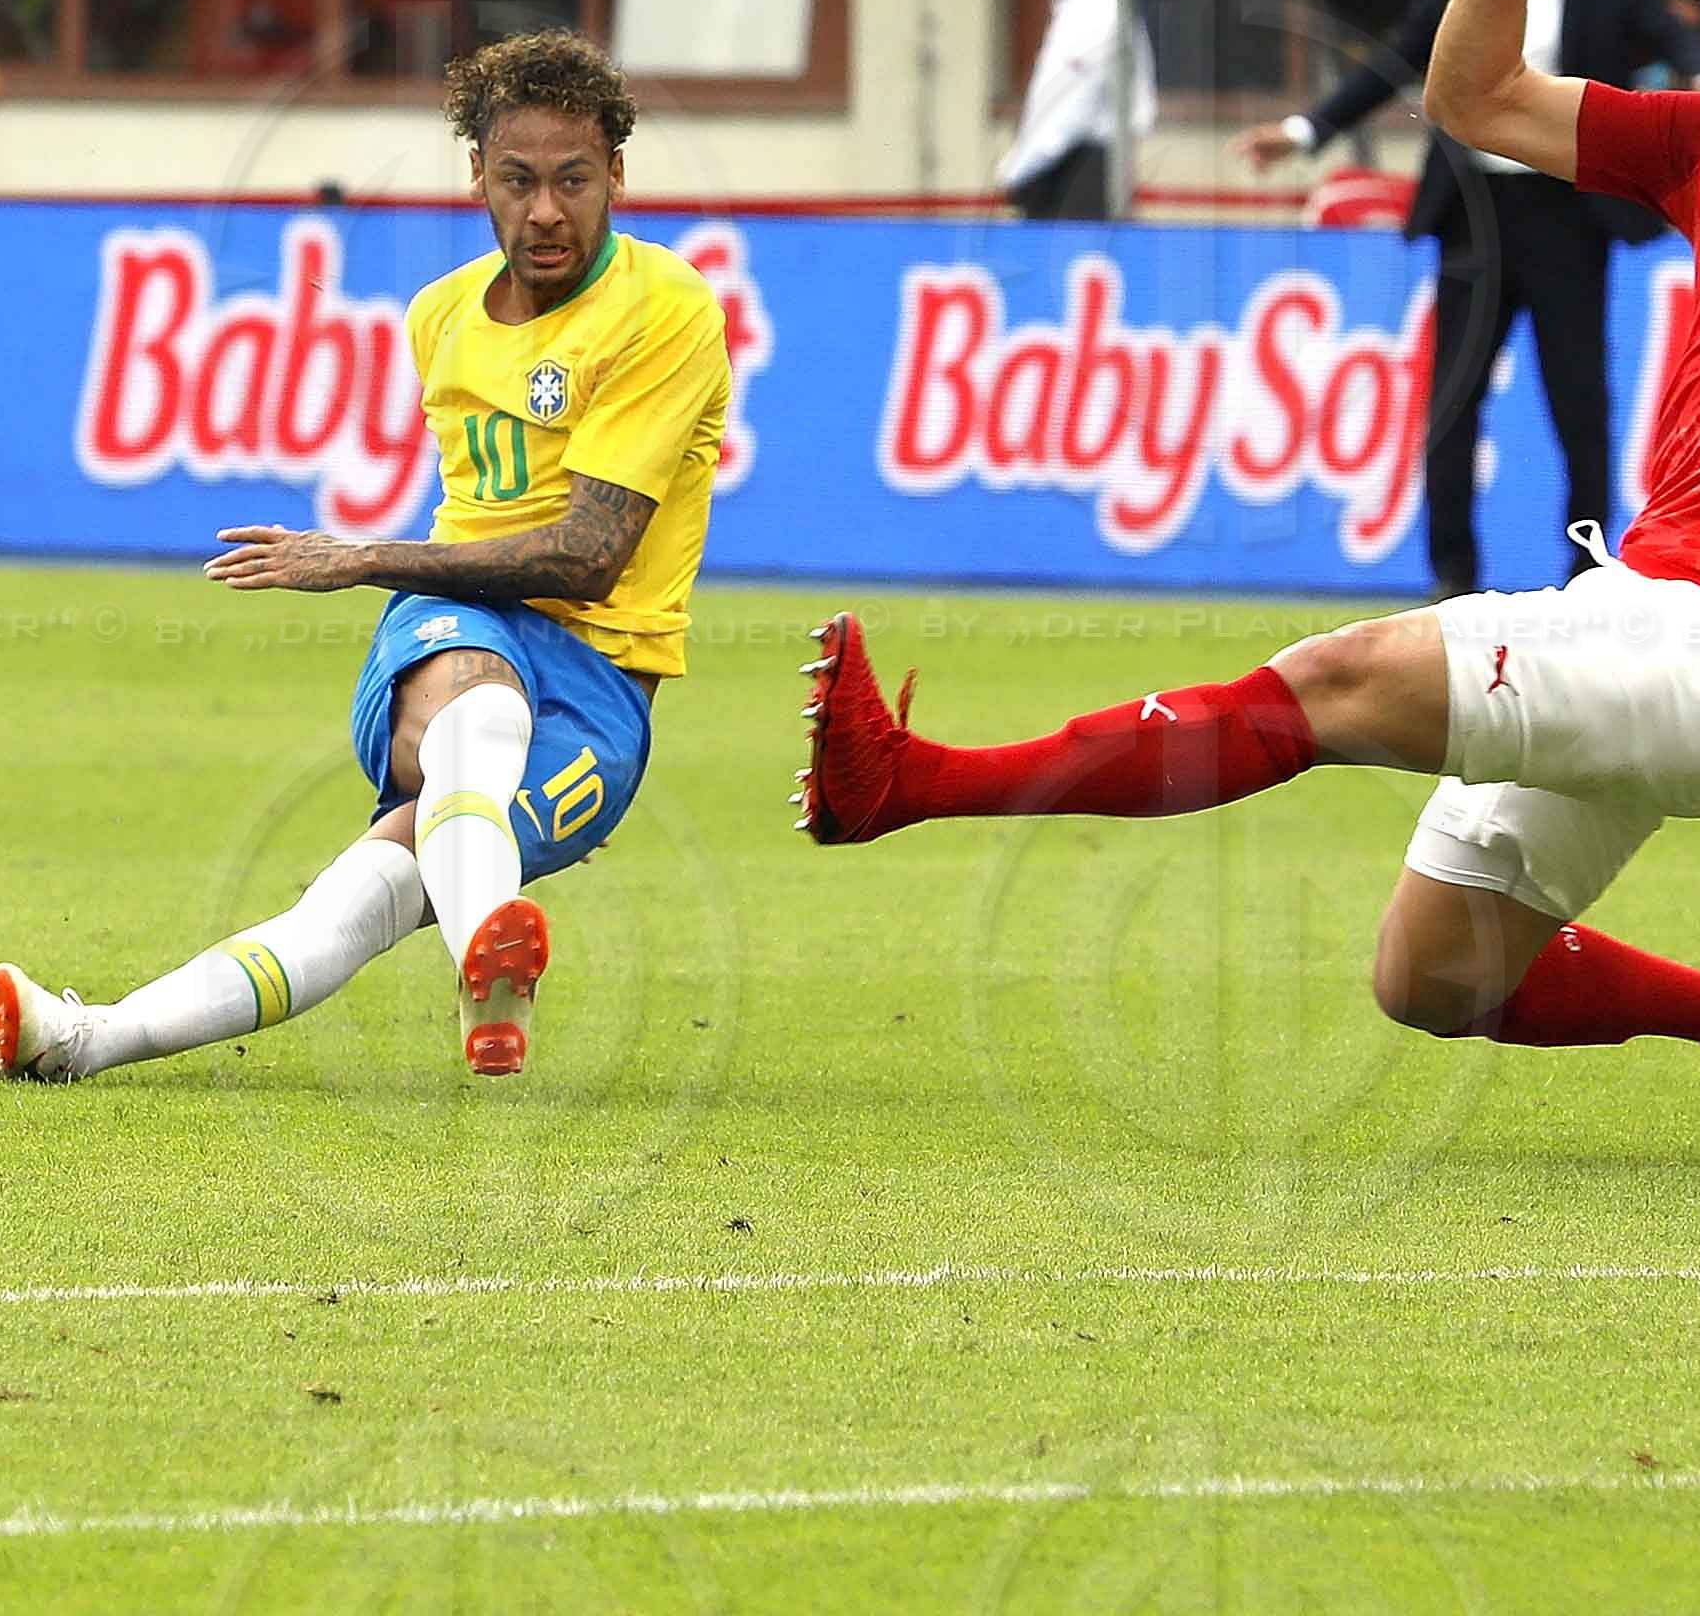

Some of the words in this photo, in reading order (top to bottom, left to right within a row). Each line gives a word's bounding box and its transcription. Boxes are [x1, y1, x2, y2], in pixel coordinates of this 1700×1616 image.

[464, 410, 530, 500] 10
[896, 276, 1437, 537] BabySof
[541, 745, 604, 842] 10
